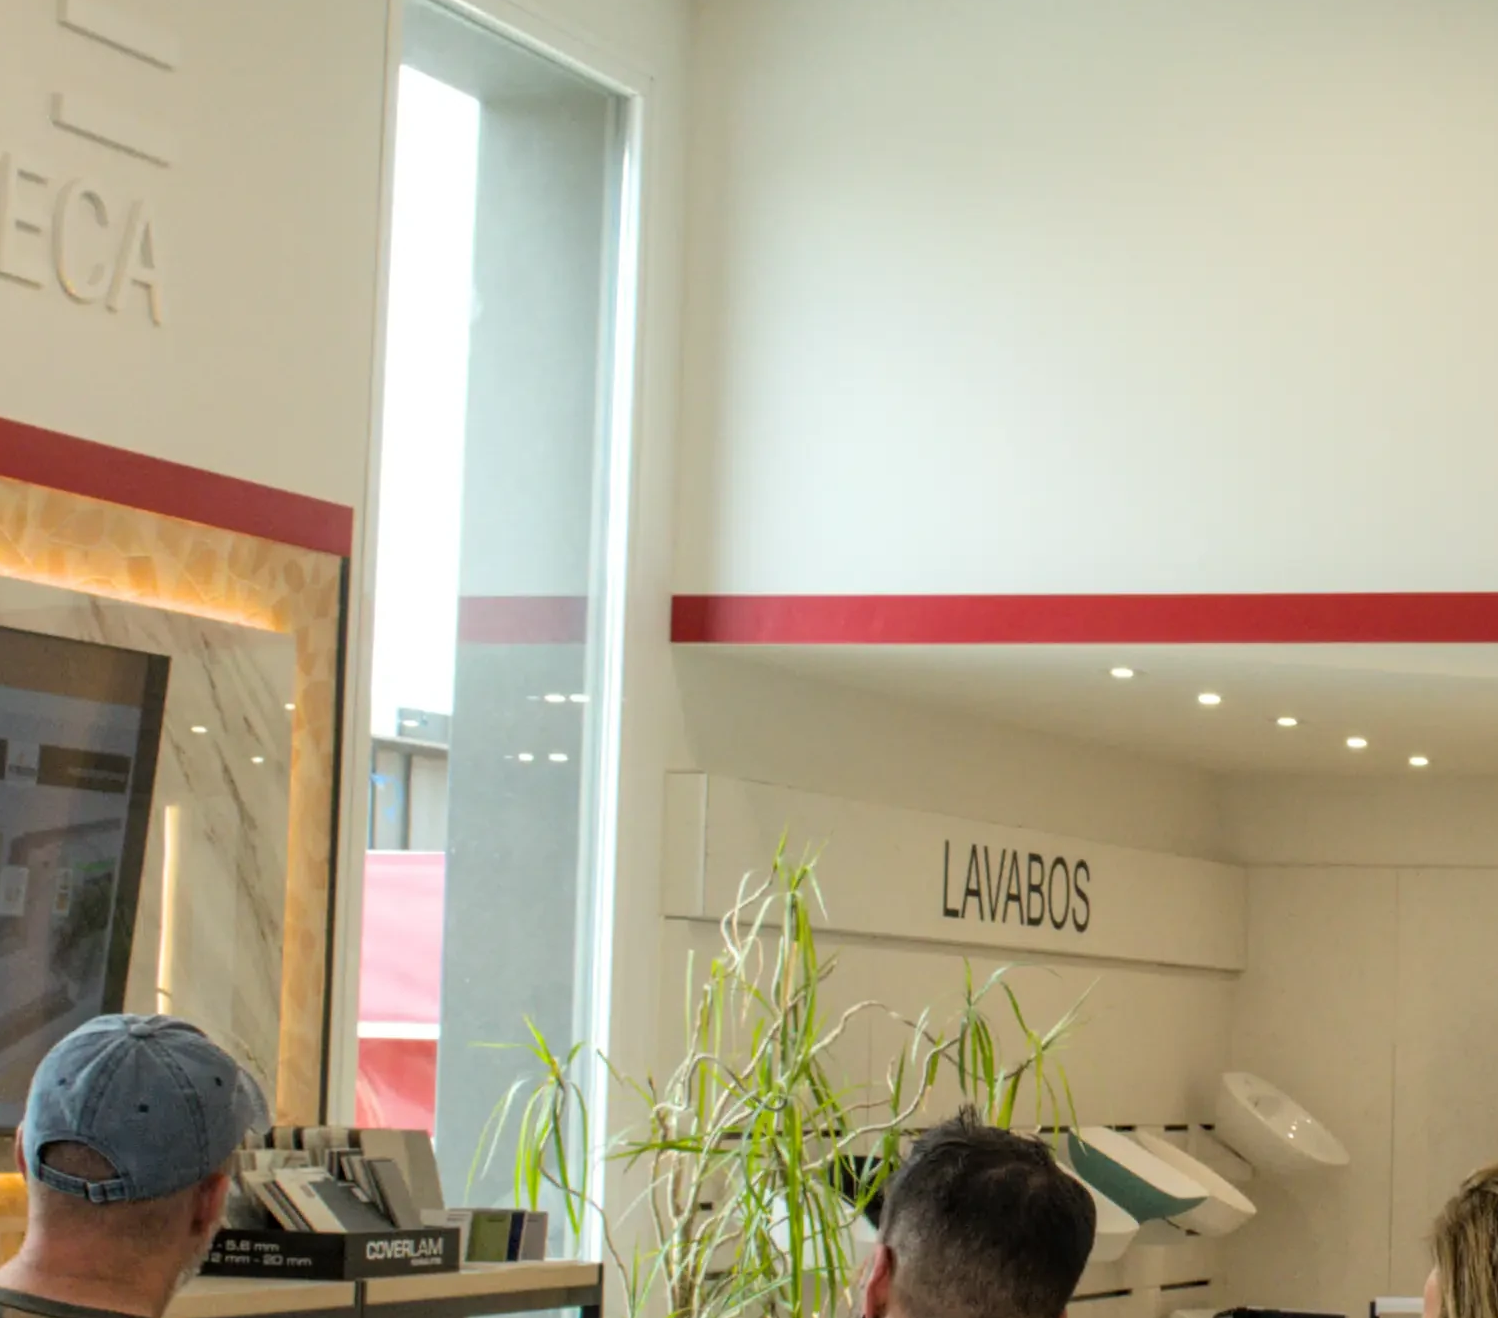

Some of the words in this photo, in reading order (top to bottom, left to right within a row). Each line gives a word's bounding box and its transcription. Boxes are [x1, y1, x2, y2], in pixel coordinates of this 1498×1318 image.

[942, 839, 1091, 933] LAVABOS
[262, 1253, 283, 1266] 20
[286, 1255, 313, 1267] mm
[365, 1236, 445, 1260] COVERLAM
